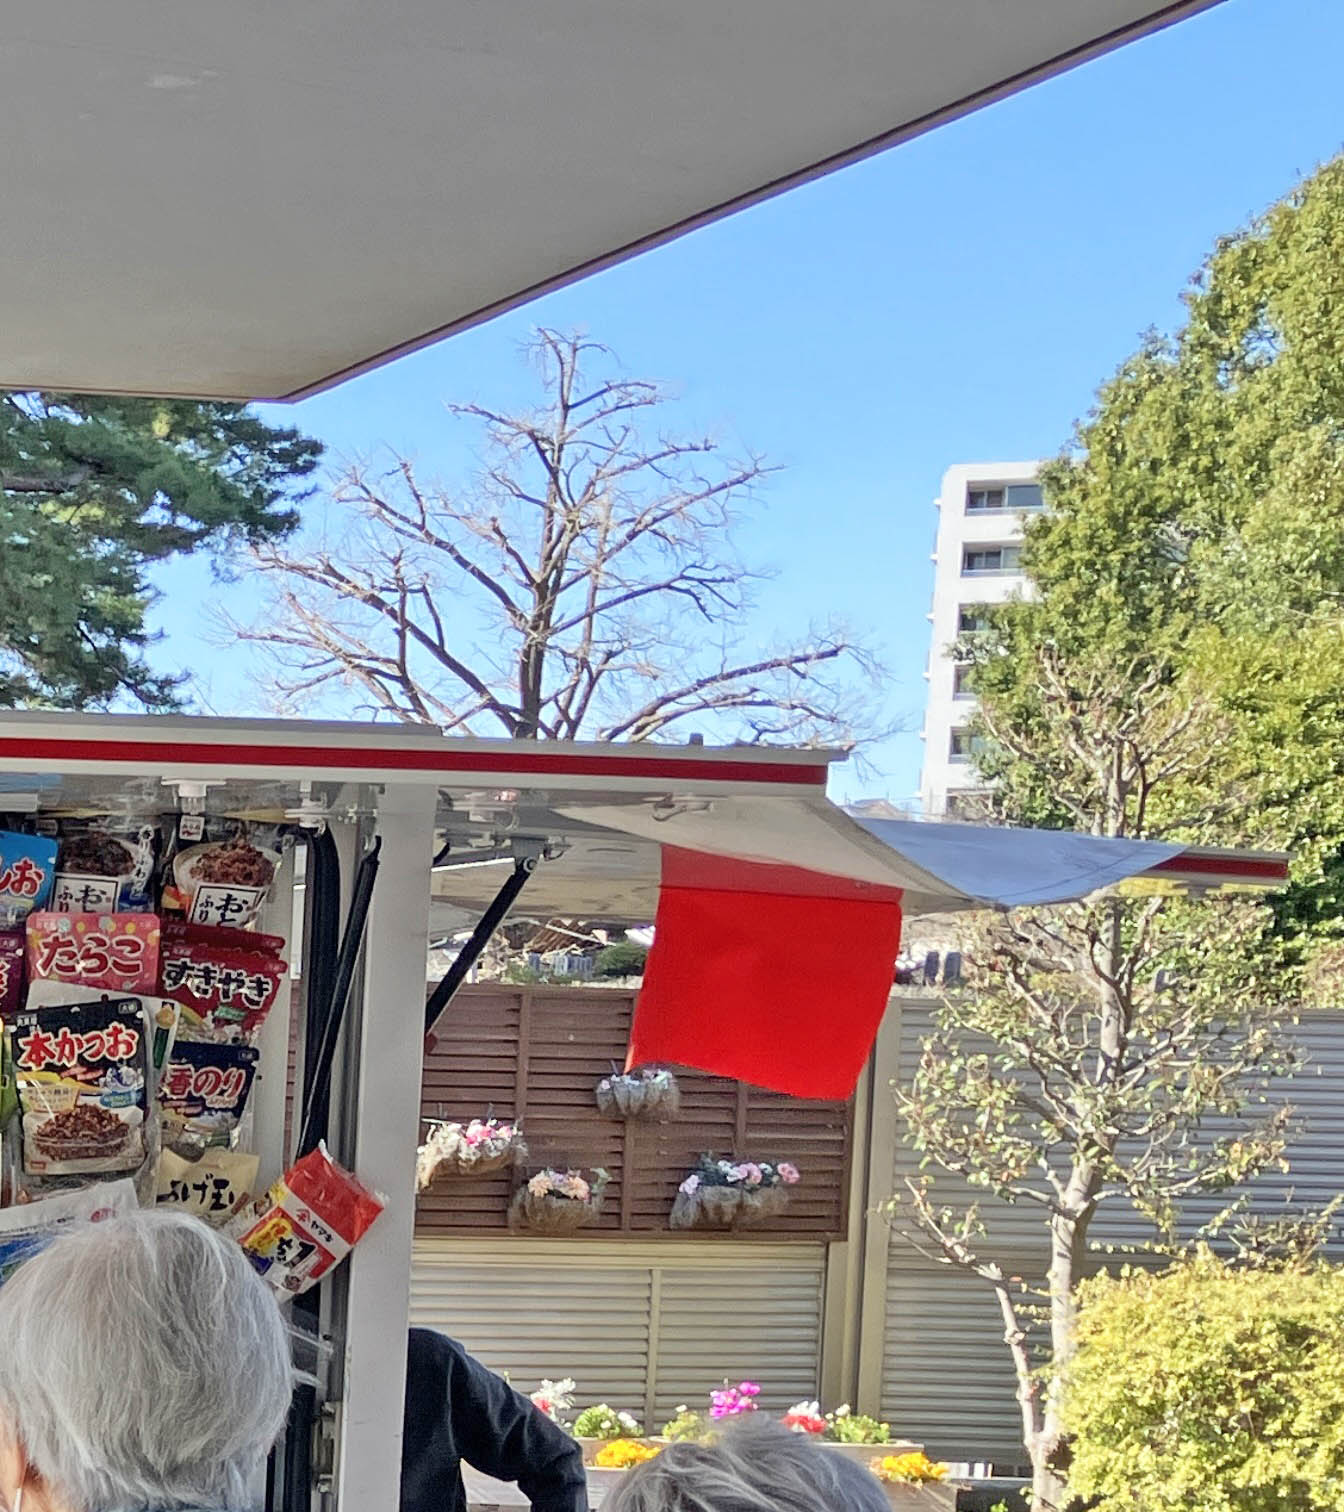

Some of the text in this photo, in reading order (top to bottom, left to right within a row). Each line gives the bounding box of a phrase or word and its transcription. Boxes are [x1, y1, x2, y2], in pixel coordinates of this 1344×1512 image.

[37, 933, 144, 976] たらこ
[165, 959, 273, 1009] すきやき
[18, 1022, 140, 1070] 本かつお
[164, 1064, 247, 1099] 香のり
[311, 1219, 335, 1244] ヤマキ
